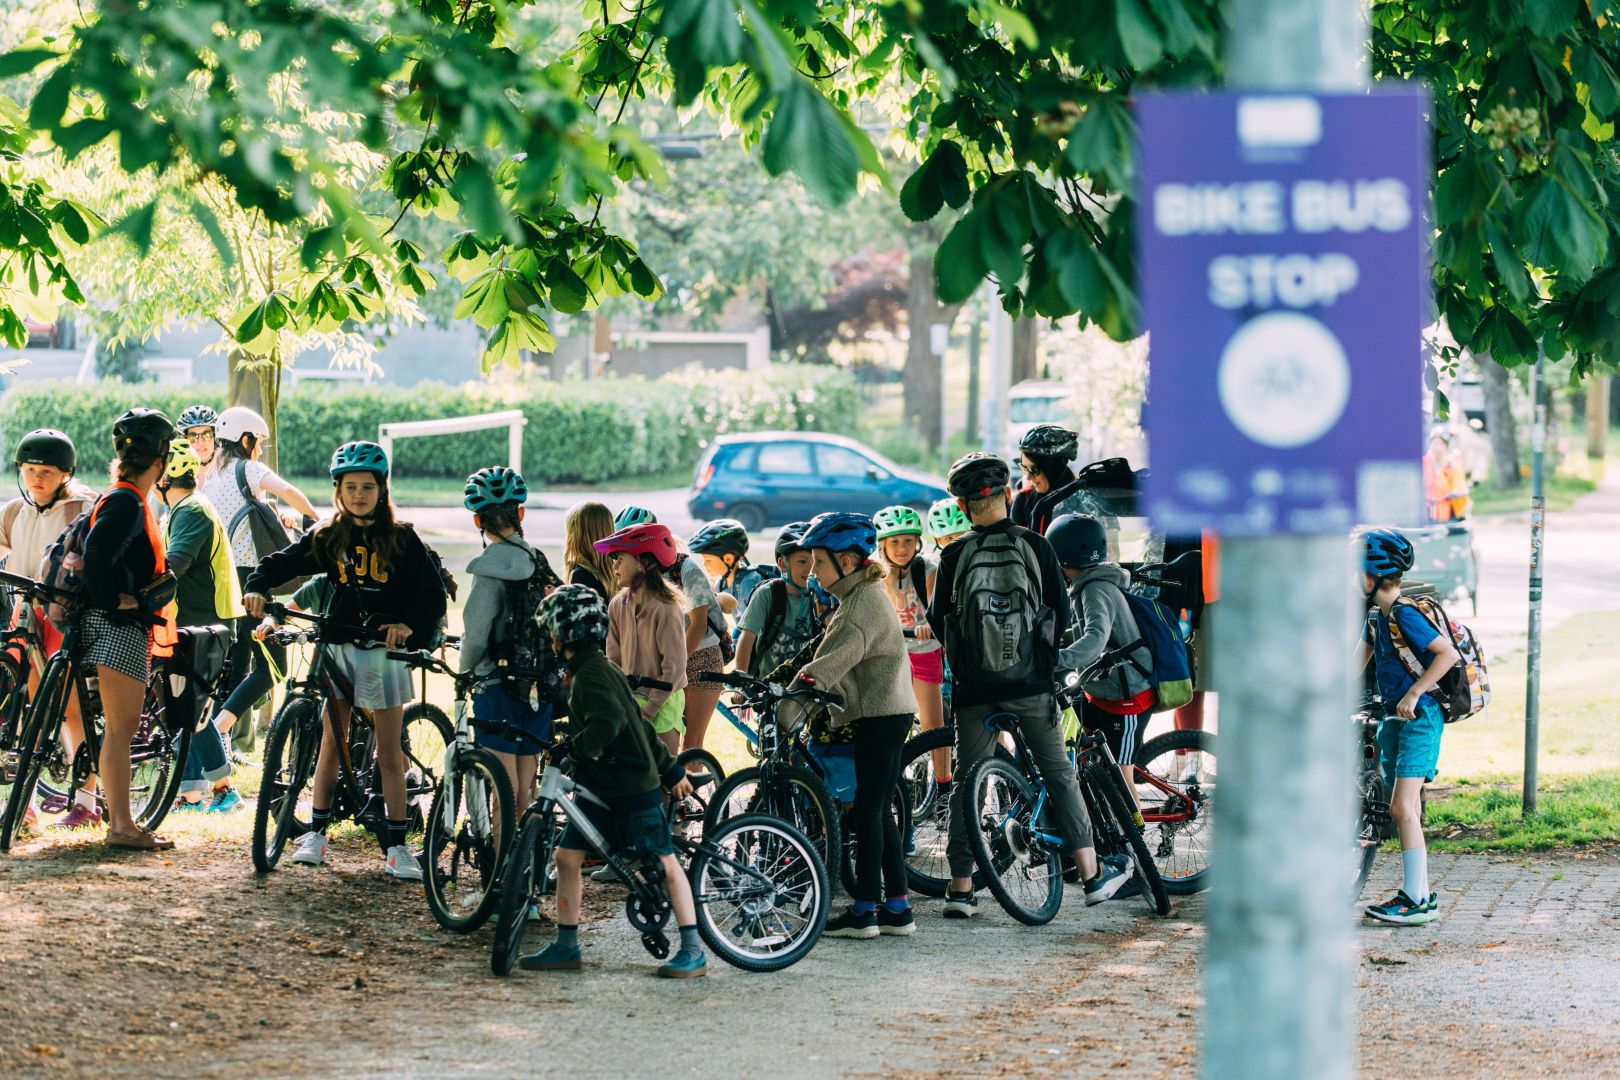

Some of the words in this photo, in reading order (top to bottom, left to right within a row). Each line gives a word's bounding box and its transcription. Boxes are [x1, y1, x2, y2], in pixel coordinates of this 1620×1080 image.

[1154, 184, 1285, 235] BIKE
[1292, 179, 1411, 232] BUS
[1208, 254, 1358, 307] STOP
[1002, 623, 1014, 660] ROOTS
